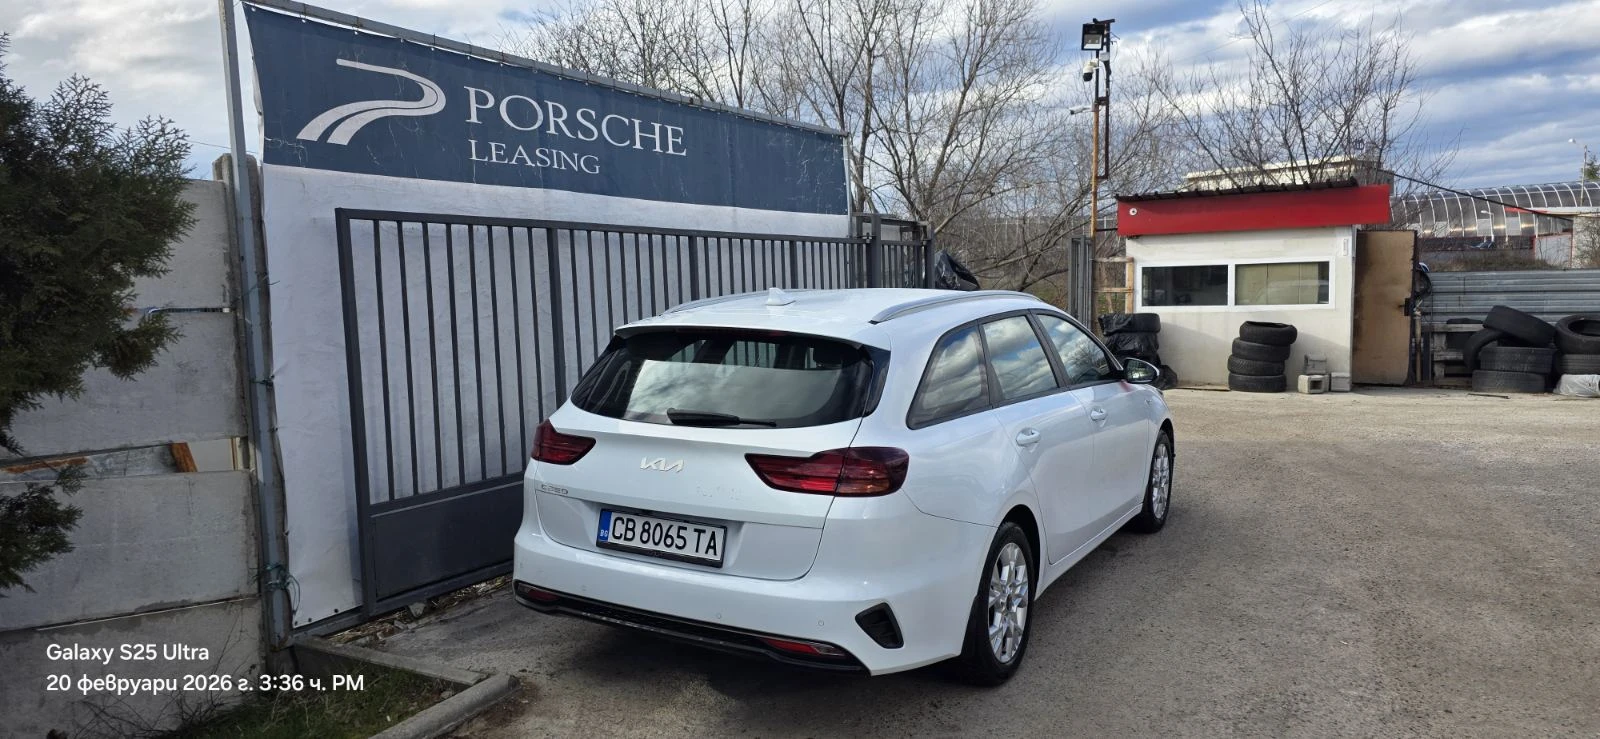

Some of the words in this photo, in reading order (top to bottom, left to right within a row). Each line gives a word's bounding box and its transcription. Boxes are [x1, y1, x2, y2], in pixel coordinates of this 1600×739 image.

[464, 86, 687, 156] PORSCHE
[468, 139, 600, 174] LEASING
[640, 457, 684, 473] KIA
[599, 529, 609, 537] BG
[612, 516, 636, 541] CB
[640, 521, 687, 550] 8065
[693, 528, 718, 556] TA
